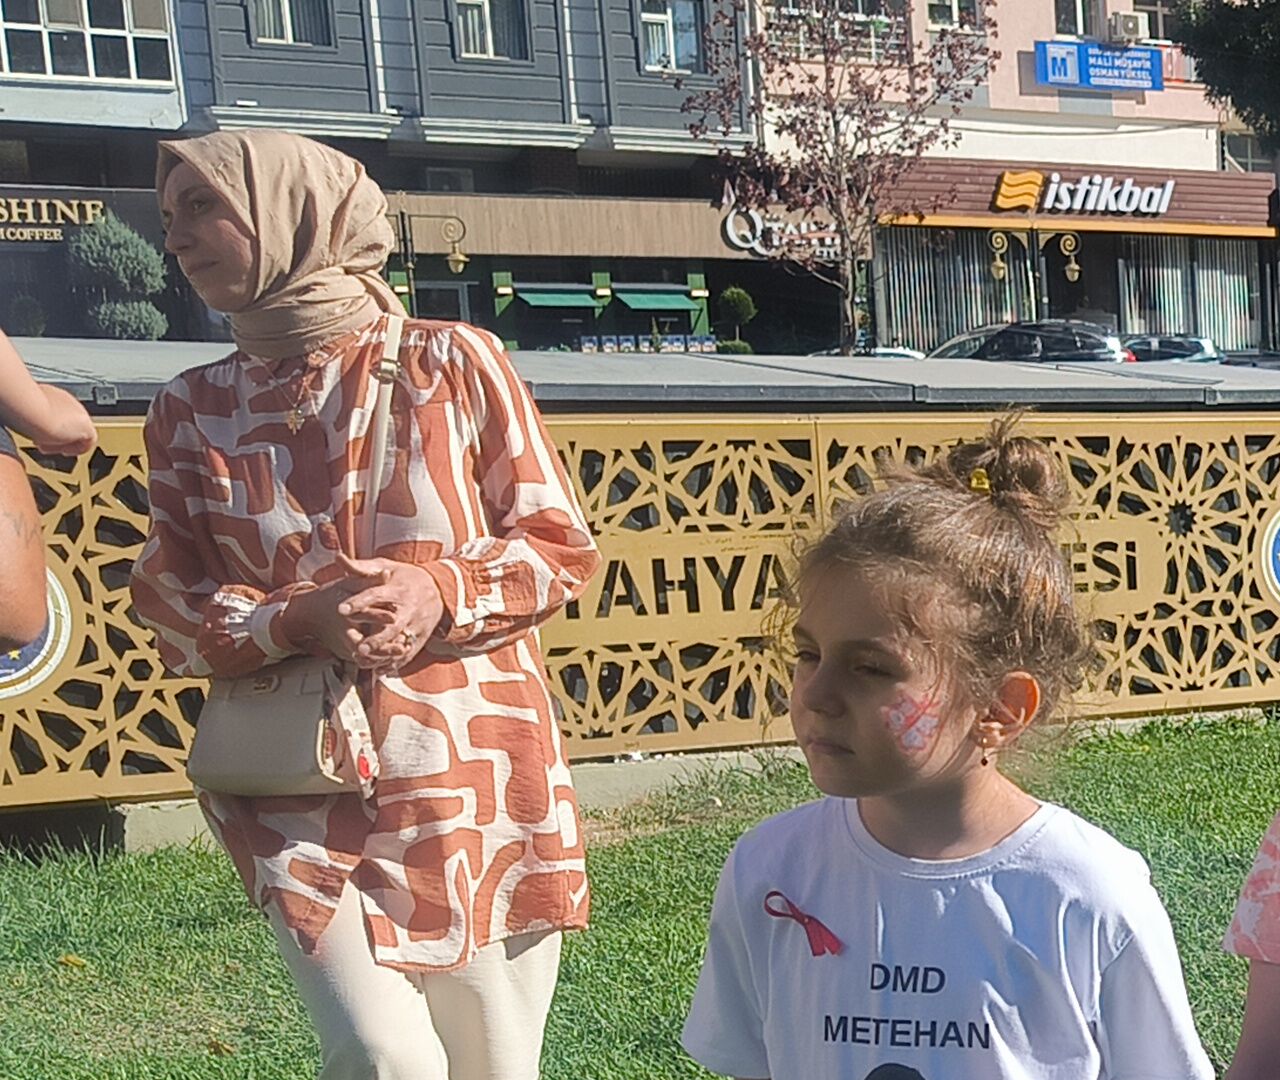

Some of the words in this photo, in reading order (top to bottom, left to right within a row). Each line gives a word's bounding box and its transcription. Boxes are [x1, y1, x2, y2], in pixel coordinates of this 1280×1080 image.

[1044, 172, 1176, 214] istikbal
[869, 963, 947, 994] DMD
[823, 1015, 991, 1050] METEHAN
